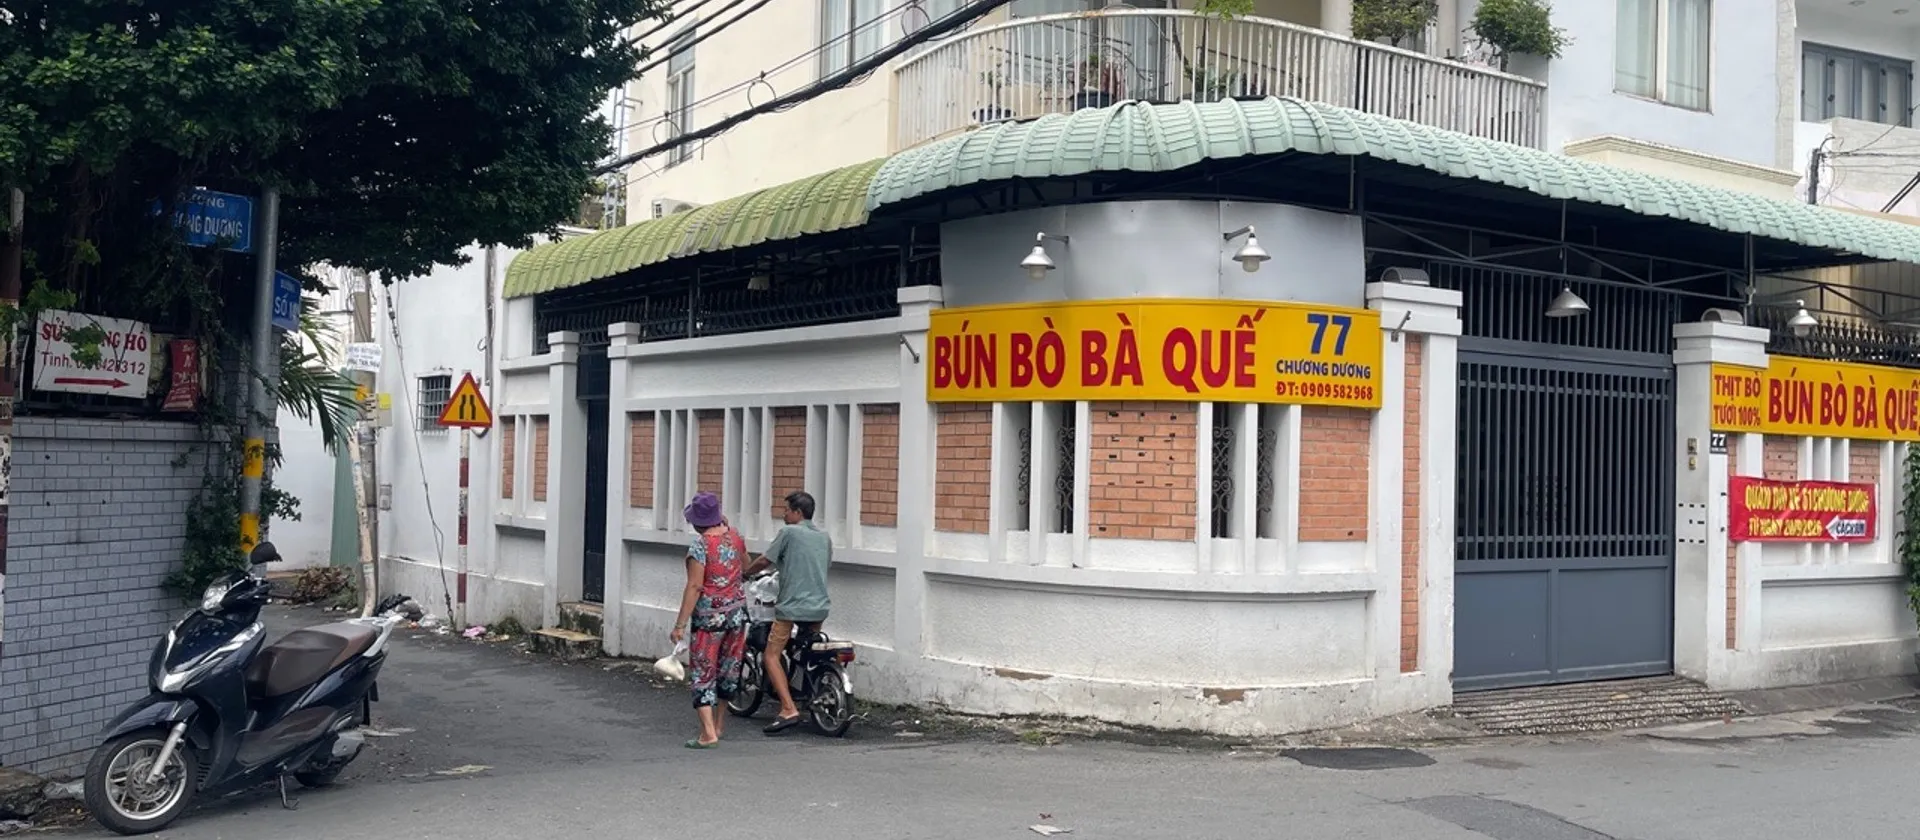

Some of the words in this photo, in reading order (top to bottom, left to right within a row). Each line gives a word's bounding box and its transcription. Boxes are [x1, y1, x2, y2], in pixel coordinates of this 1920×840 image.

[1307, 313, 1352, 356] 77
[935, 320, 997, 389] BÚN
[1011, 317, 1066, 389] BÒ
[1081, 312, 1144, 387] BÀ
[1162, 308, 1267, 393] QUẾ
[1276, 359, 1329, 376] CHƯƠNG
[1331, 361, 1371, 379] DƯƠNG
[1714, 374, 1742, 401] THỊT
[1744, 371, 1761, 397] BÒ
[1769, 367, 1814, 425] BÚN
[1820, 371, 1847, 427] BÒ
[1853, 375, 1878, 428] BÀ
[1713, 402, 1736, 425] TƯƠI
[1739, 405, 1761, 426] 100%
[1712, 433, 1726, 446] 77
